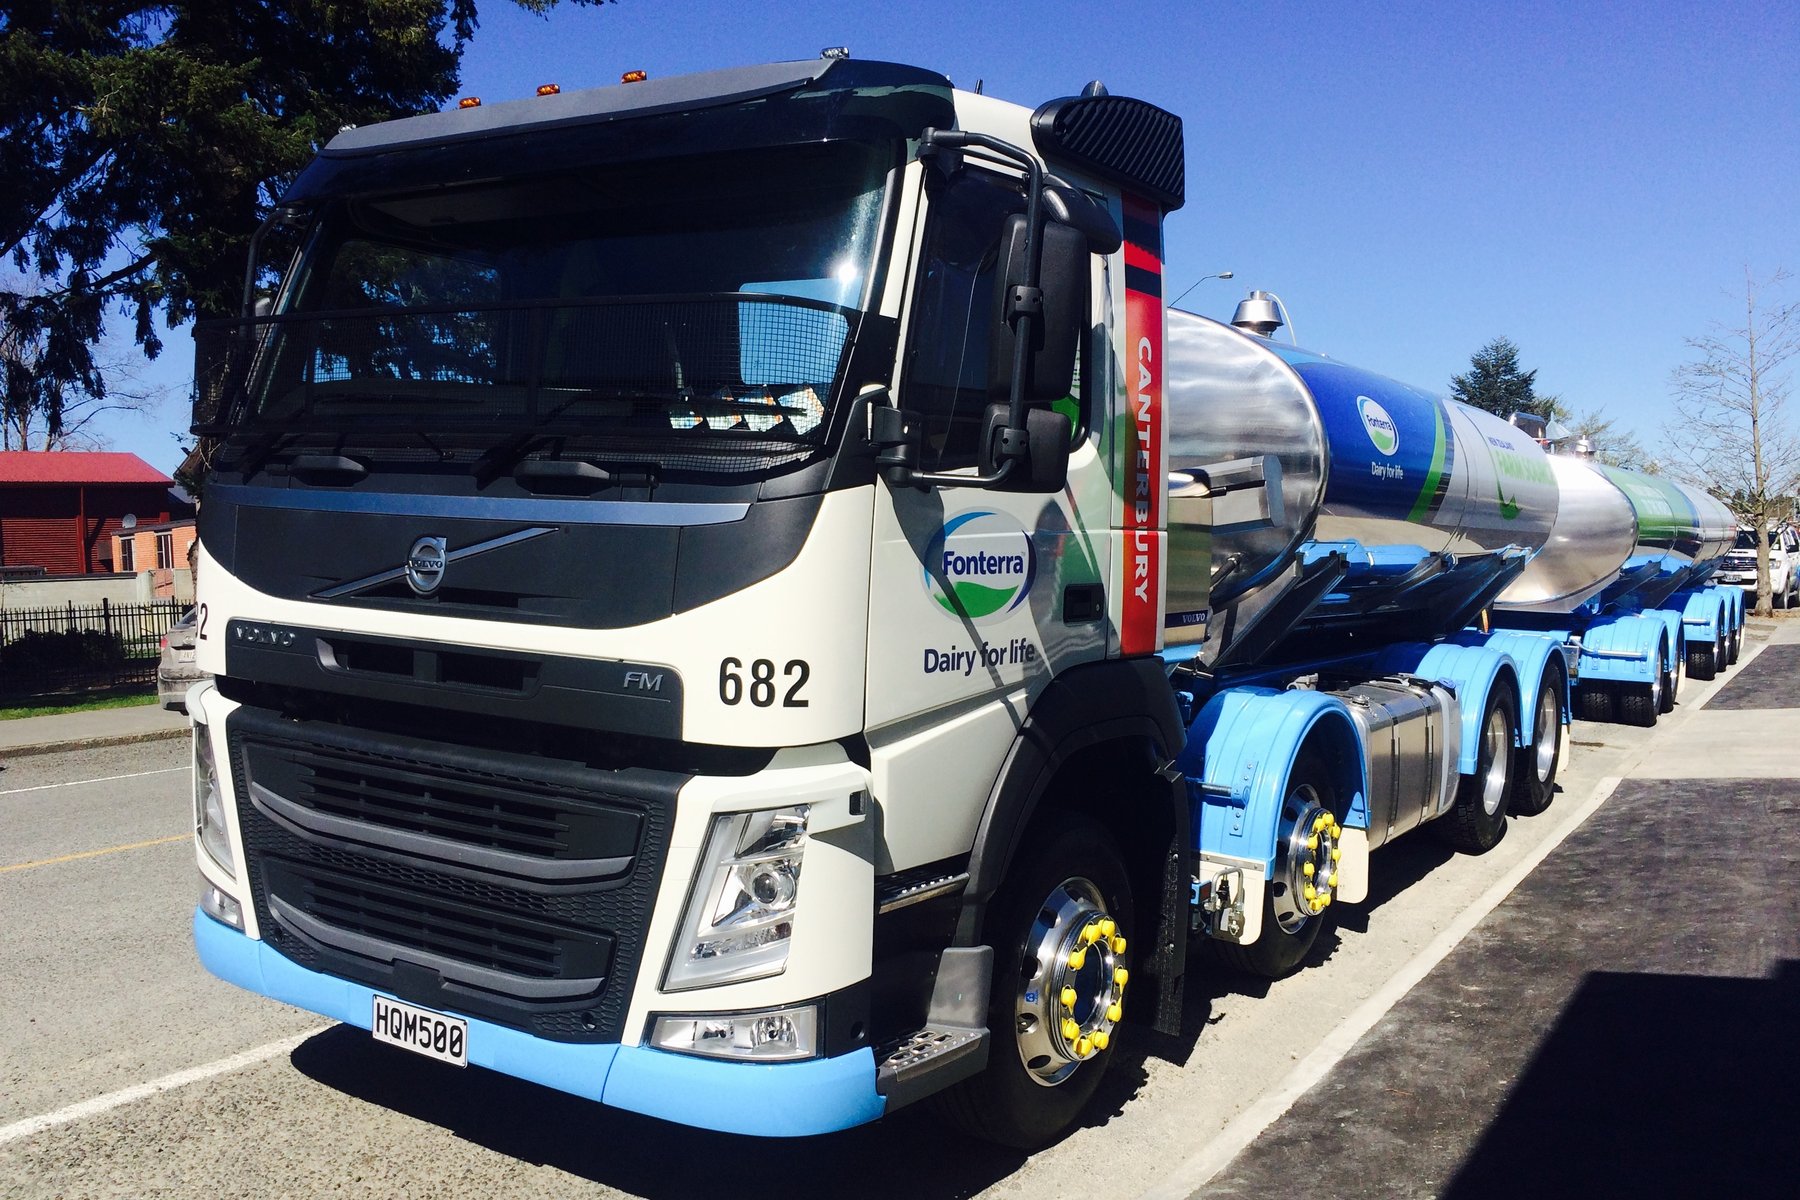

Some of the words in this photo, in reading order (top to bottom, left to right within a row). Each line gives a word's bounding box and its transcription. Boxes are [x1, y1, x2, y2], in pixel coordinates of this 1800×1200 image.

[1366, 414, 1392, 431] Fonterra
[1134, 336, 1152, 603] CANTERBURY
[1371, 461, 1386, 480] Dairy
[1386, 463, 1395, 478] for
[1395, 465, 1403, 479] life
[408, 559, 444, 569] VOLVO
[943, 551, 1024, 576] Fonterra
[1182, 612, 1206, 623] VOLVO
[235, 626, 297, 647] VOLVO
[923, 645, 977, 677] Dairy
[979, 641, 1008, 668] for
[1009, 637, 1036, 664] life
[623, 671, 664, 691] FM
[718, 656, 811, 708] 682
[376, 1002, 464, 1058] HQM500
